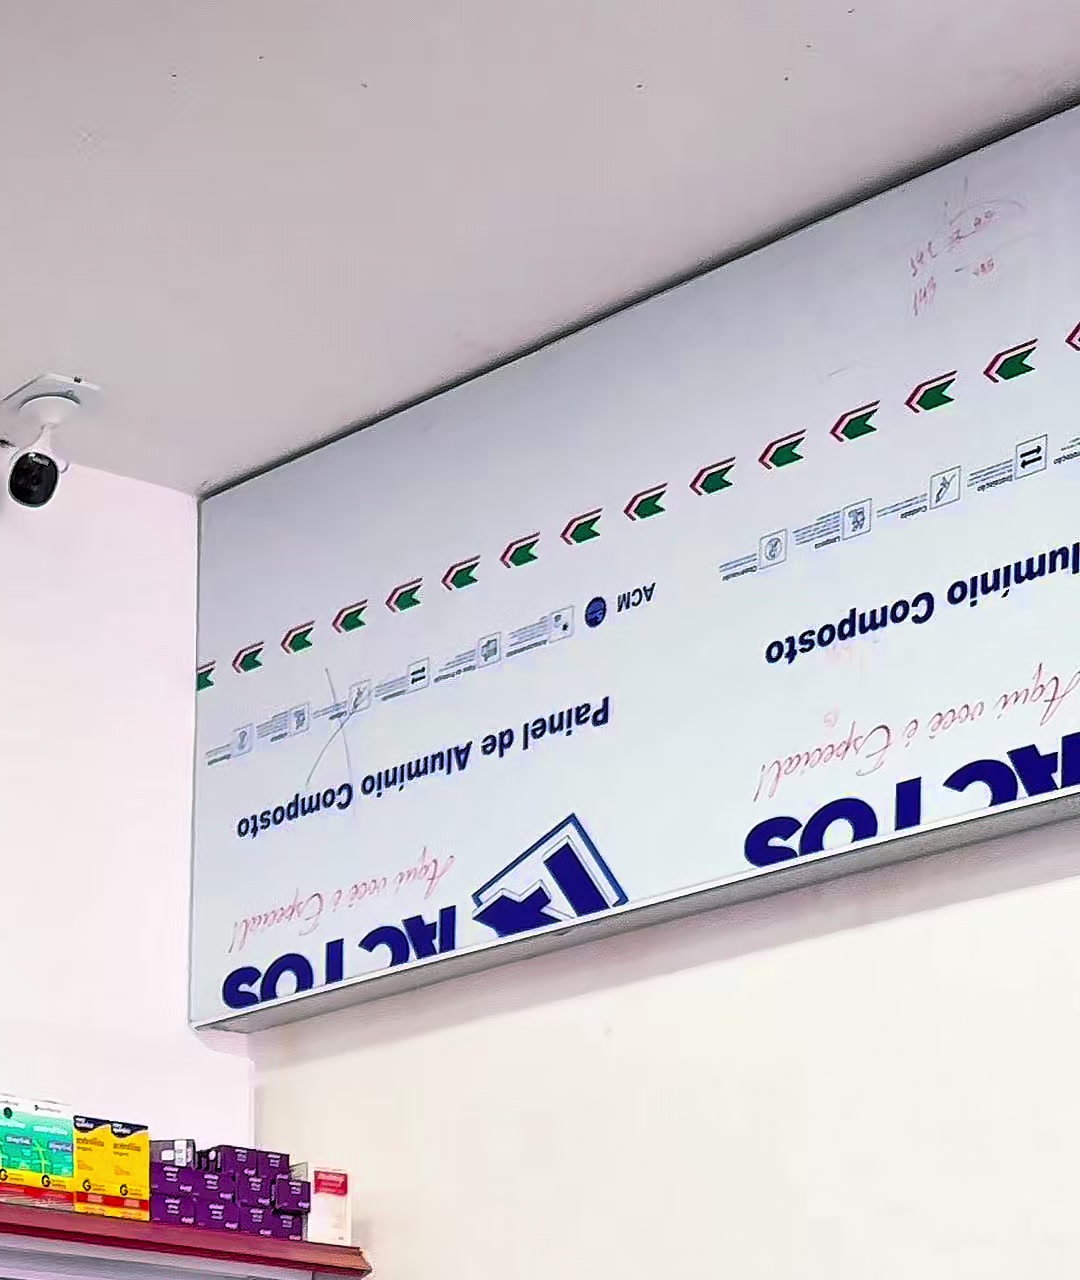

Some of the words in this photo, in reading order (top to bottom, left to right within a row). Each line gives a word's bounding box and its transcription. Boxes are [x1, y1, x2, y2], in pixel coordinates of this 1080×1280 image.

[617, 582, 656, 613] ACM
[765, 592, 934, 663] Composto
[482, 728, 514, 757] de
[523, 696, 610, 751] Painel
[930, 702, 984, 739] você
[361, 741, 471, 796] Alumínio
[753, 721, 894, 802] Especial!
[236, 782, 353, 839] Composto
[341, 874, 380, 904] você
[388, 846, 456, 900] Aqui
[227, 887, 325, 953] Especial!
